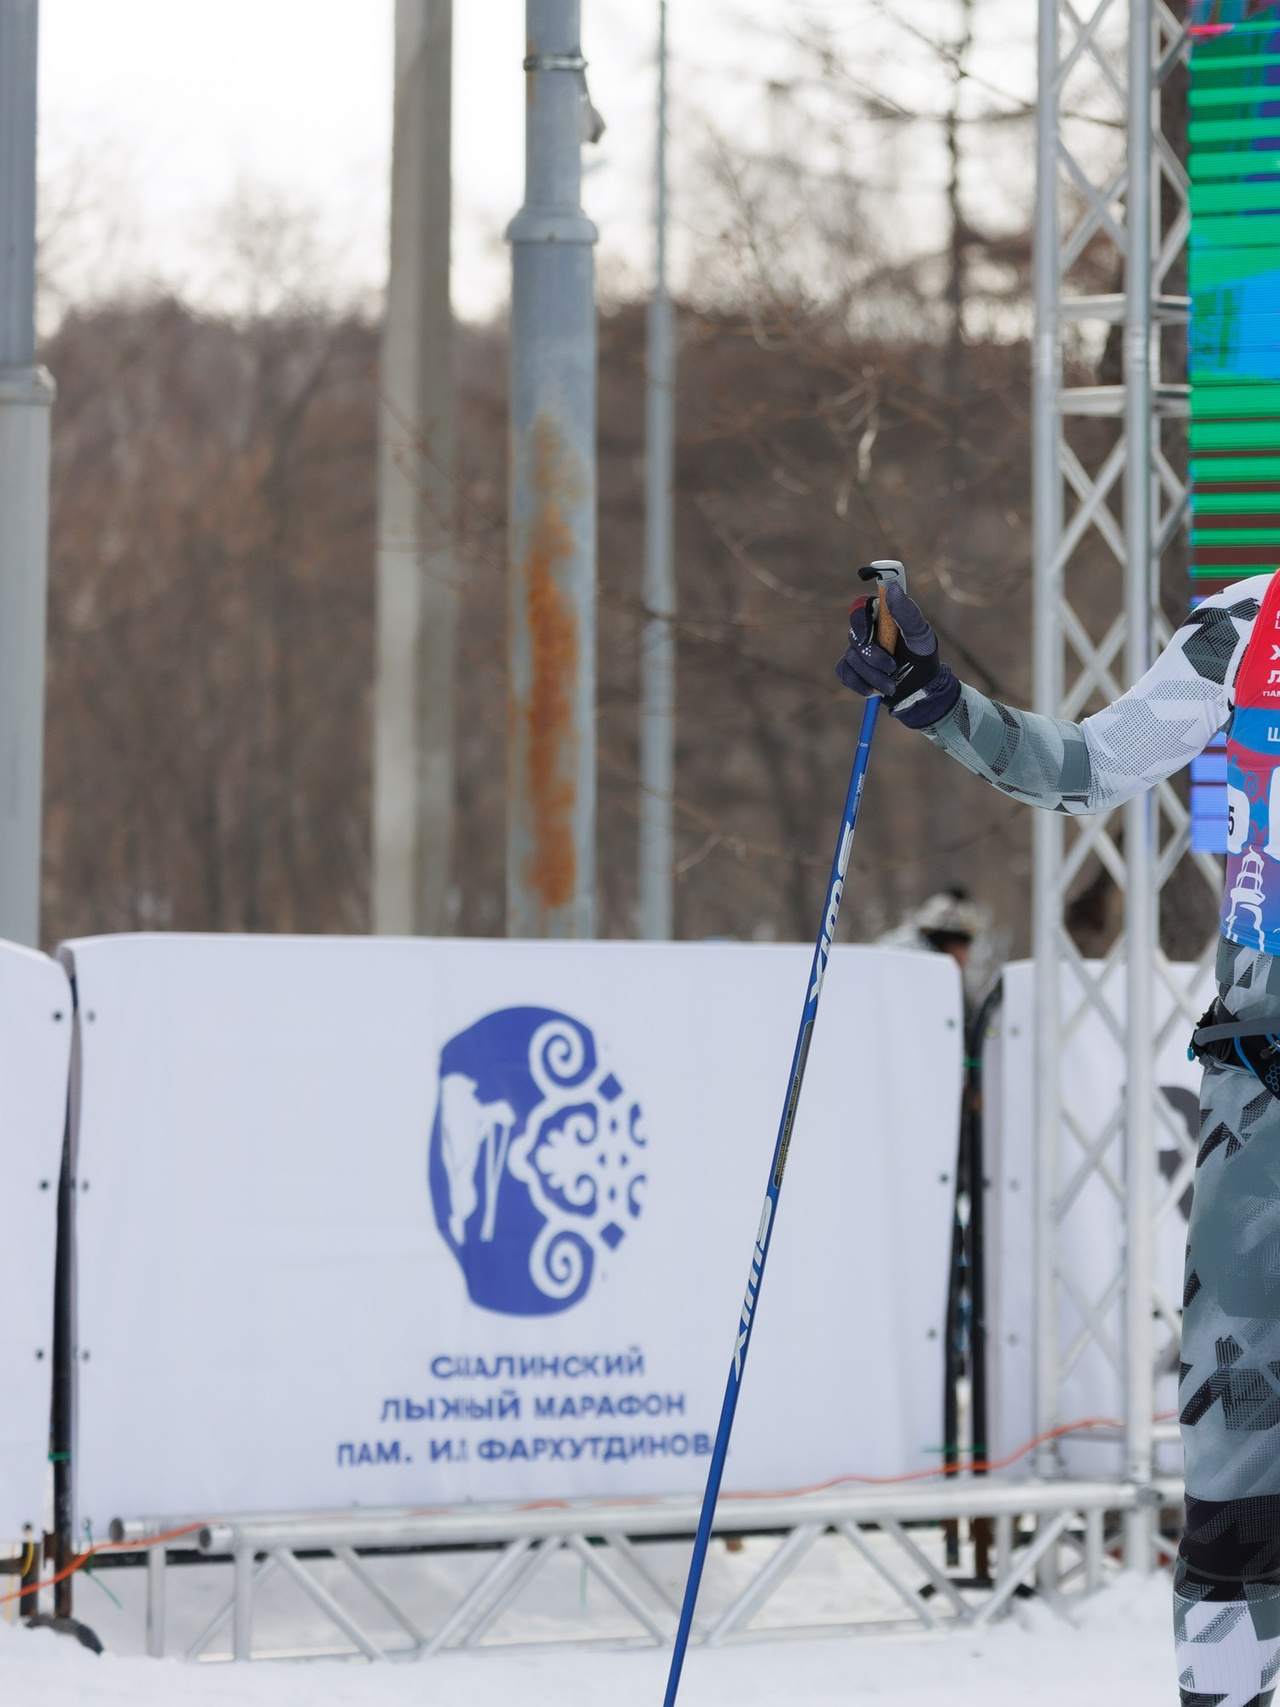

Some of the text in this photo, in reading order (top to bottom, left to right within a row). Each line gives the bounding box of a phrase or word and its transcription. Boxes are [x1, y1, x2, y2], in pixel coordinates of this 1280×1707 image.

[534, 1394, 686, 1419] МАРАФОН
[338, 1440, 413, 1467] ПАМ.
[477, 1433, 719, 1464] ФАРХУТДИНОВ
